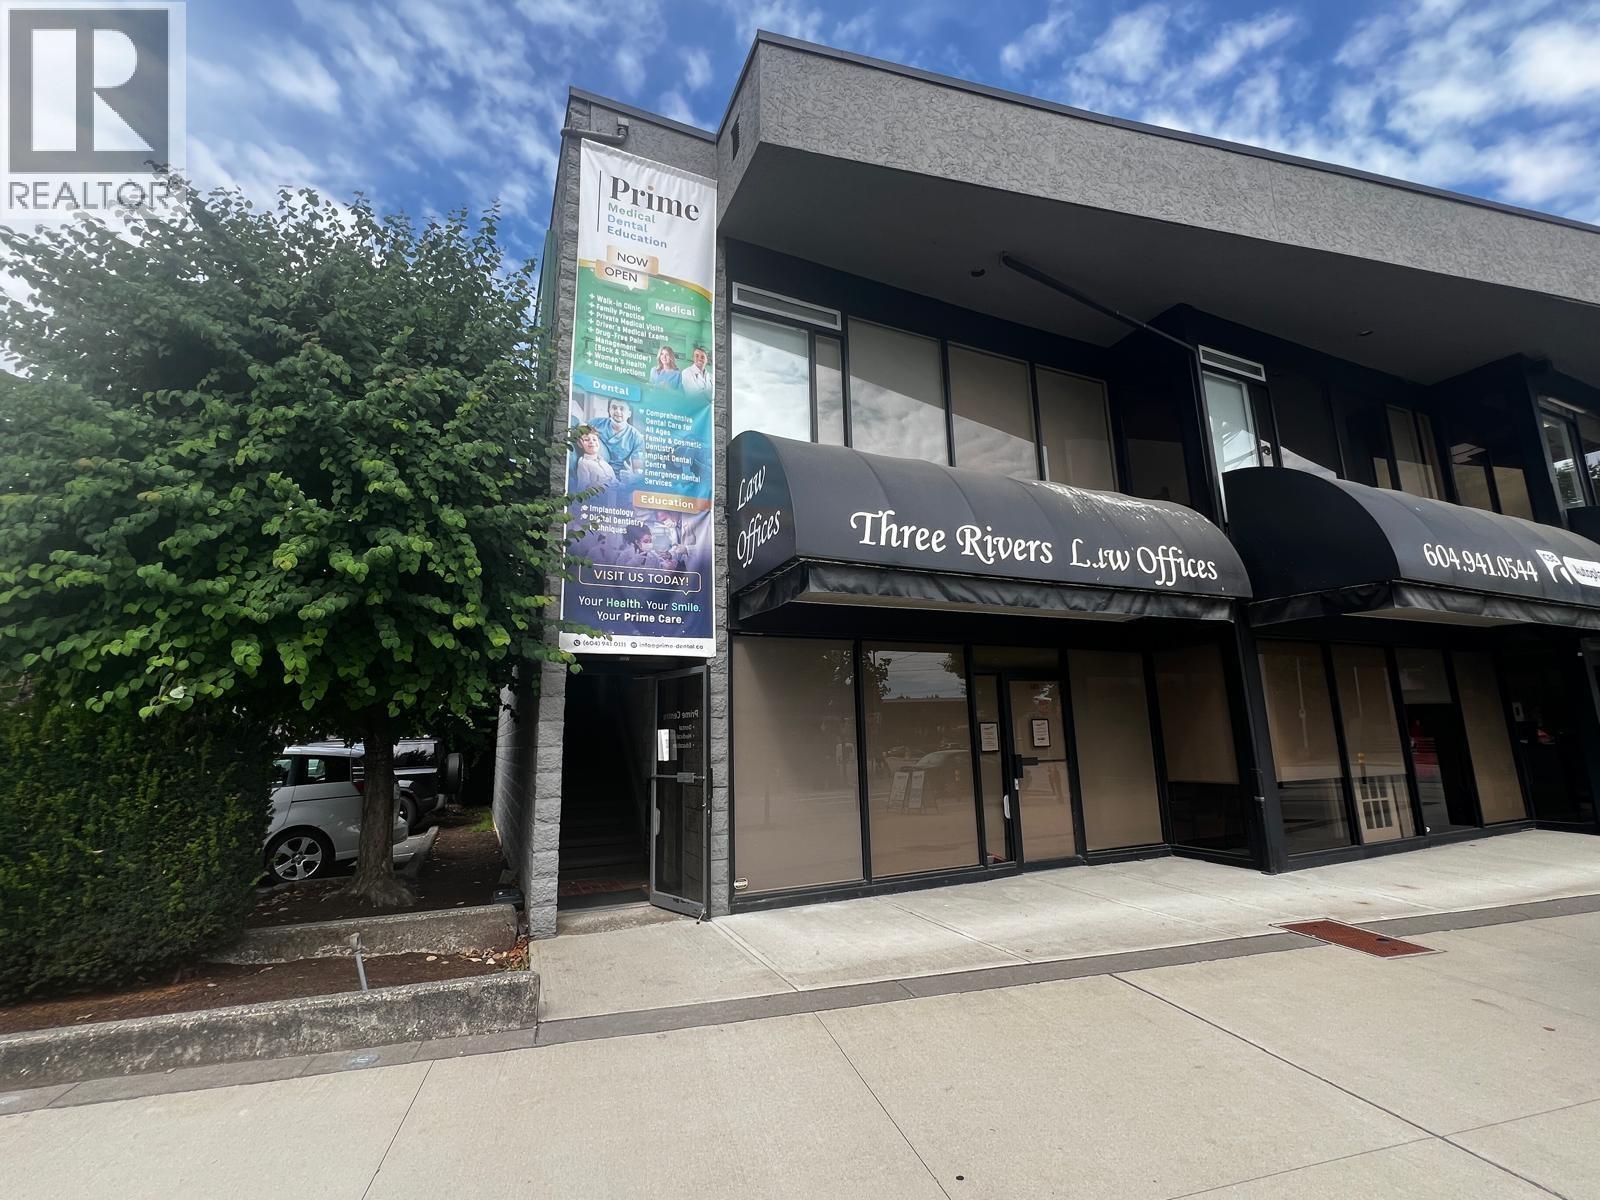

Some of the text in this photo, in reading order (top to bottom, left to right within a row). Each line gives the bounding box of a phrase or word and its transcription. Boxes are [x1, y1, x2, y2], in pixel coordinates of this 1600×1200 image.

[609, 175, 700, 222] Prime
[607, 202, 656, 224] Medical
[607, 214, 648, 233] Dental
[607, 225, 668, 249] Education
[617, 251, 649, 268] NOW
[604, 266, 638, 283] OPEN
[596, 303, 645, 321] Family Practice
[655, 302, 696, 317] Medical
[596, 311, 664, 334] Private Medical Visits
[622, 326, 647, 337] Medical
[648, 331, 669, 342] Exams
[629, 336, 644, 345] Pain
[595, 335, 637, 352] Management
[614, 364, 646, 378] Injections
[625, 359, 647, 369] Health
[592, 380, 630, 396] Dental
[645, 417, 667, 427] Dental
[645, 434, 667, 445] Family
[673, 438, 702, 450] Cosmetic
[645, 441, 675, 454] Dentistry
[645, 451, 692, 465] Implant Dental
[645, 460, 667, 470] Centre
[644, 468, 701, 484] Emergency Dental
[644, 477, 673, 488] Services
[736, 465, 767, 511] Law
[640, 495, 694, 510] Education
[589, 504, 634, 518] Implantology
[589, 513, 644, 528] Digtal Dentistry
[736, 510, 781, 569] Offices
[849, 509, 947, 553] Three
[956, 524, 1053, 565] Rivers
[1136, 545, 1218, 587] Offices
[1423, 543, 1539, 583] 604.941.0544
[594, 569, 689, 586] VISIT US TODAY!
[578, 595, 701, 612] Your Health. Your Smile.
[597, 611, 685, 624] Your Prime Care.
